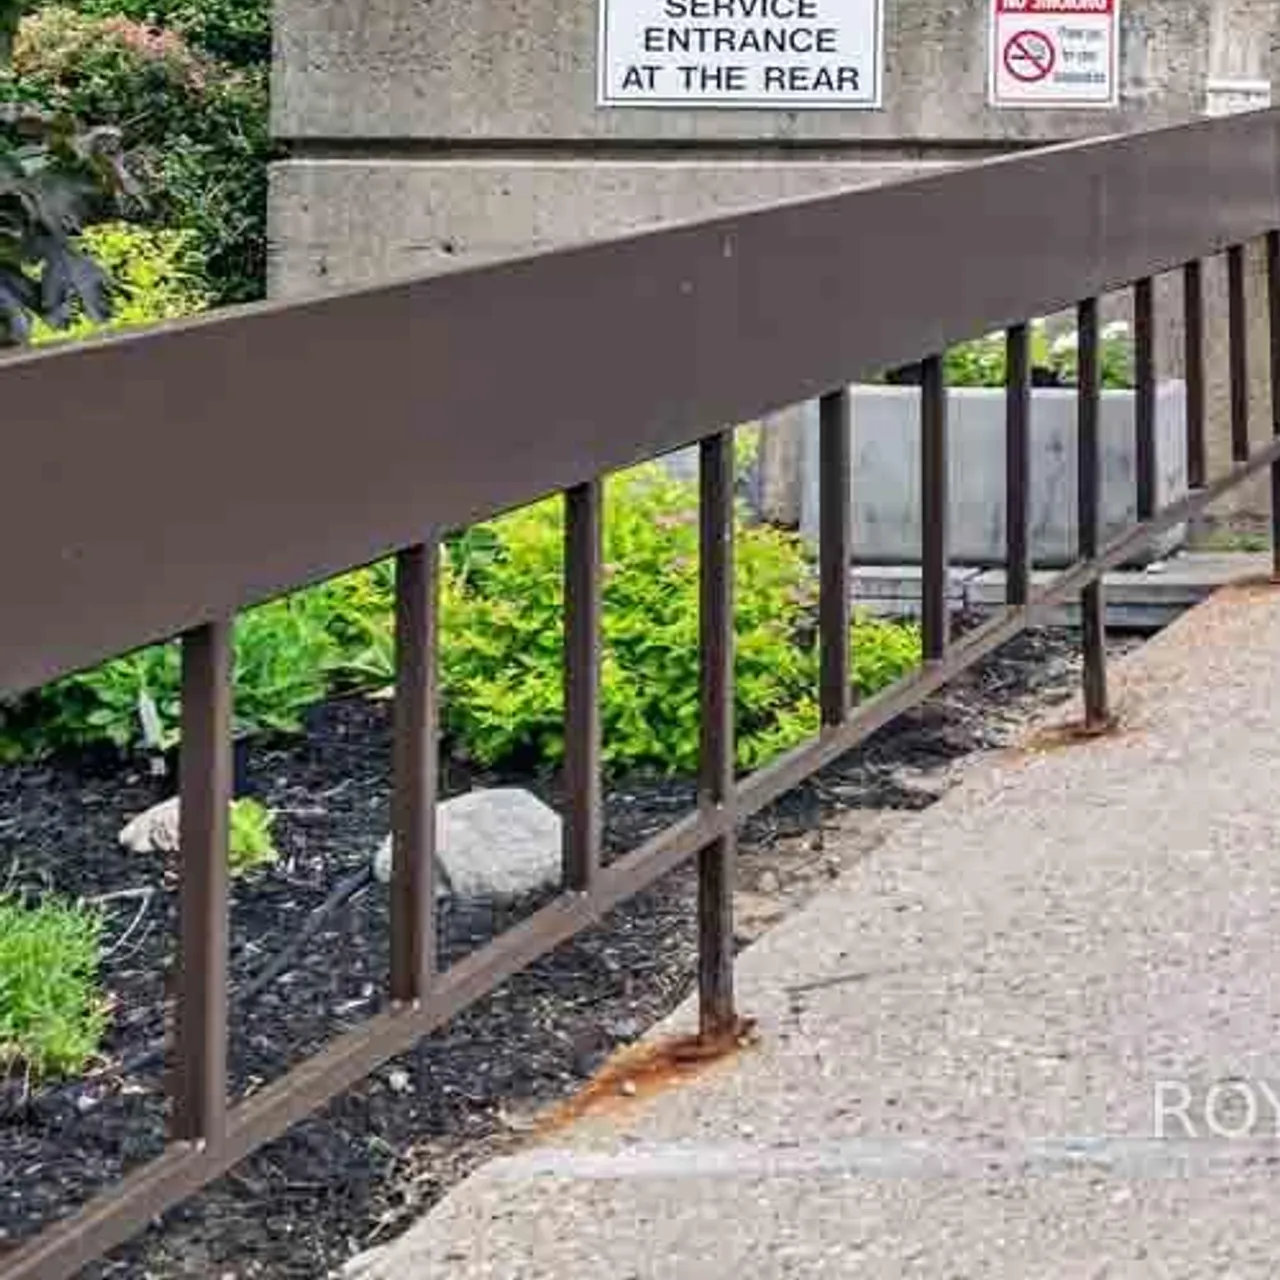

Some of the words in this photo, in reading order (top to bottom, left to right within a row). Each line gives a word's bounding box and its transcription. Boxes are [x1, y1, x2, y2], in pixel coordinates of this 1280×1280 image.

[644, 28, 838, 52] ENTRANCE
[621, 65, 662, 90] AT
[676, 66, 747, 91] THE
[764, 66, 859, 91] REAR
